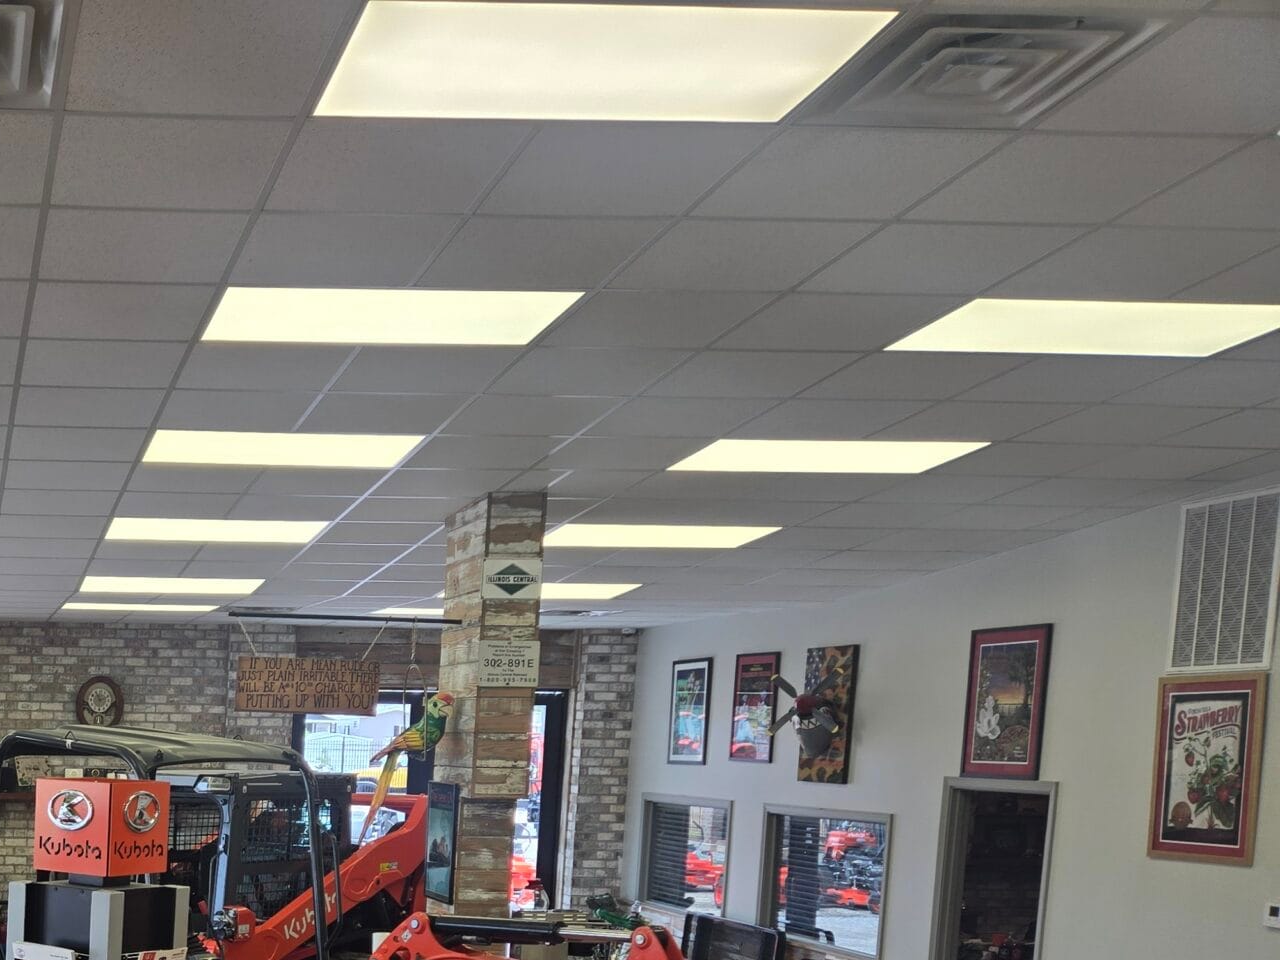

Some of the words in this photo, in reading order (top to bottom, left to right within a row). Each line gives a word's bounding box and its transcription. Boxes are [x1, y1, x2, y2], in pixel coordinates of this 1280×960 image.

[250, 656, 258, 670] IF
[264, 657, 282, 671] YOU
[287, 658, 306, 671] ARE
[311, 658, 336, 672] MEAN
[368, 661, 381, 673] OR
[483, 658, 535, 668] 302-891E
[238, 670, 264, 682] JUST
[267, 670, 296, 682] PLAIN
[299, 671, 348, 683] IRRITABLE
[349, 671, 380, 684] THERE
[238, 682, 259, 693] WILL
[263, 682, 277, 693] BE
[315, 682, 356, 695] CHARGE
[360, 682, 377, 694] FOR
[245, 694, 290, 709] PUTTING
[295, 694, 310, 709] UP
[314, 694, 340, 709] WITH
[1174, 705, 1242, 737] STRAWBERRY
[39, 835, 102, 860] Kubota
[114, 839, 164, 860] Kubota
[283, 892, 337, 940] Kubt
